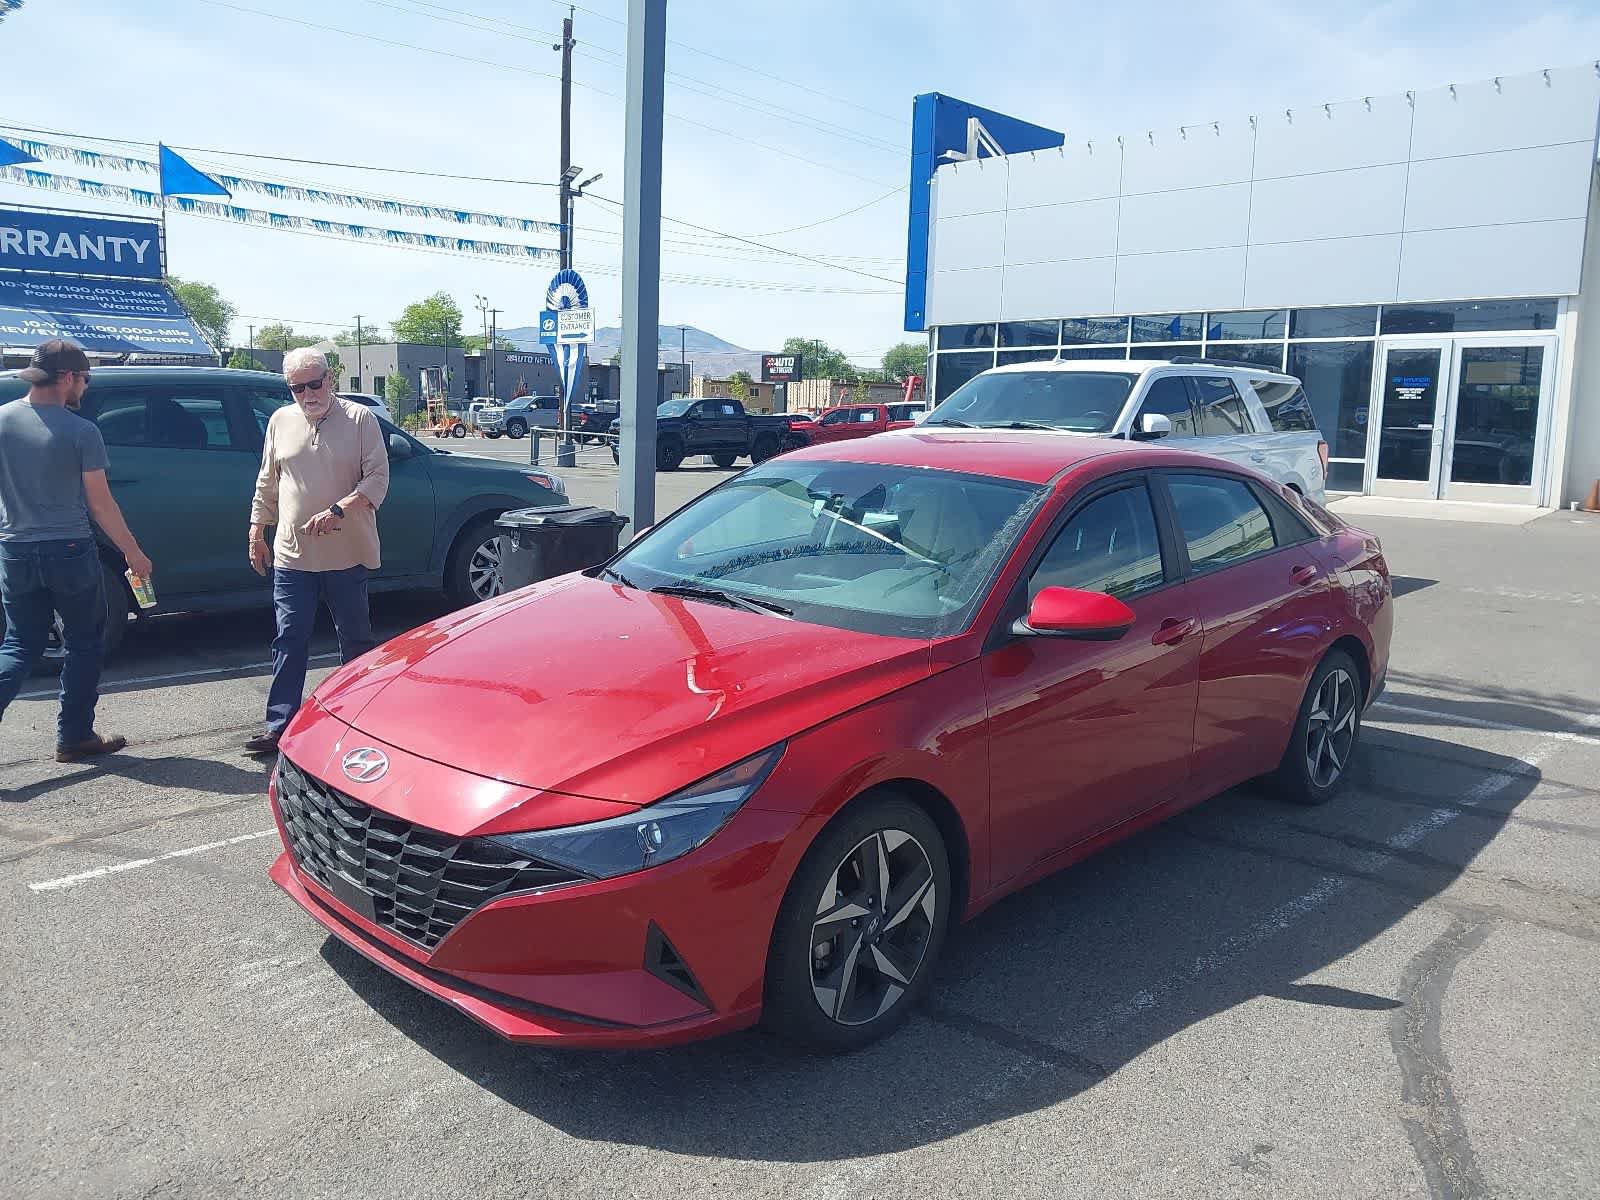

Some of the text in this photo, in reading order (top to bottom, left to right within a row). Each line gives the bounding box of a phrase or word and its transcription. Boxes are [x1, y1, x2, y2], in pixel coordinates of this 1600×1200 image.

[0, 226, 151, 264] RRANTY
[0, 280, 161, 298] 10-Year/100,000-Mile
[23, 289, 168, 306] Powertrain Limited
[98, 302, 168, 313] Warranty
[560, 311, 591, 321] CUSTOMER
[21, 320, 190, 337] 10-Year/100,000-Mile
[560, 321, 590, 330] ENTRANCE
[61, 330, 121, 341] Battery
[122, 334, 194, 345] Warranty
[512, 355, 554, 365] AUTO NETW
[774, 357, 794, 366] AUTO
